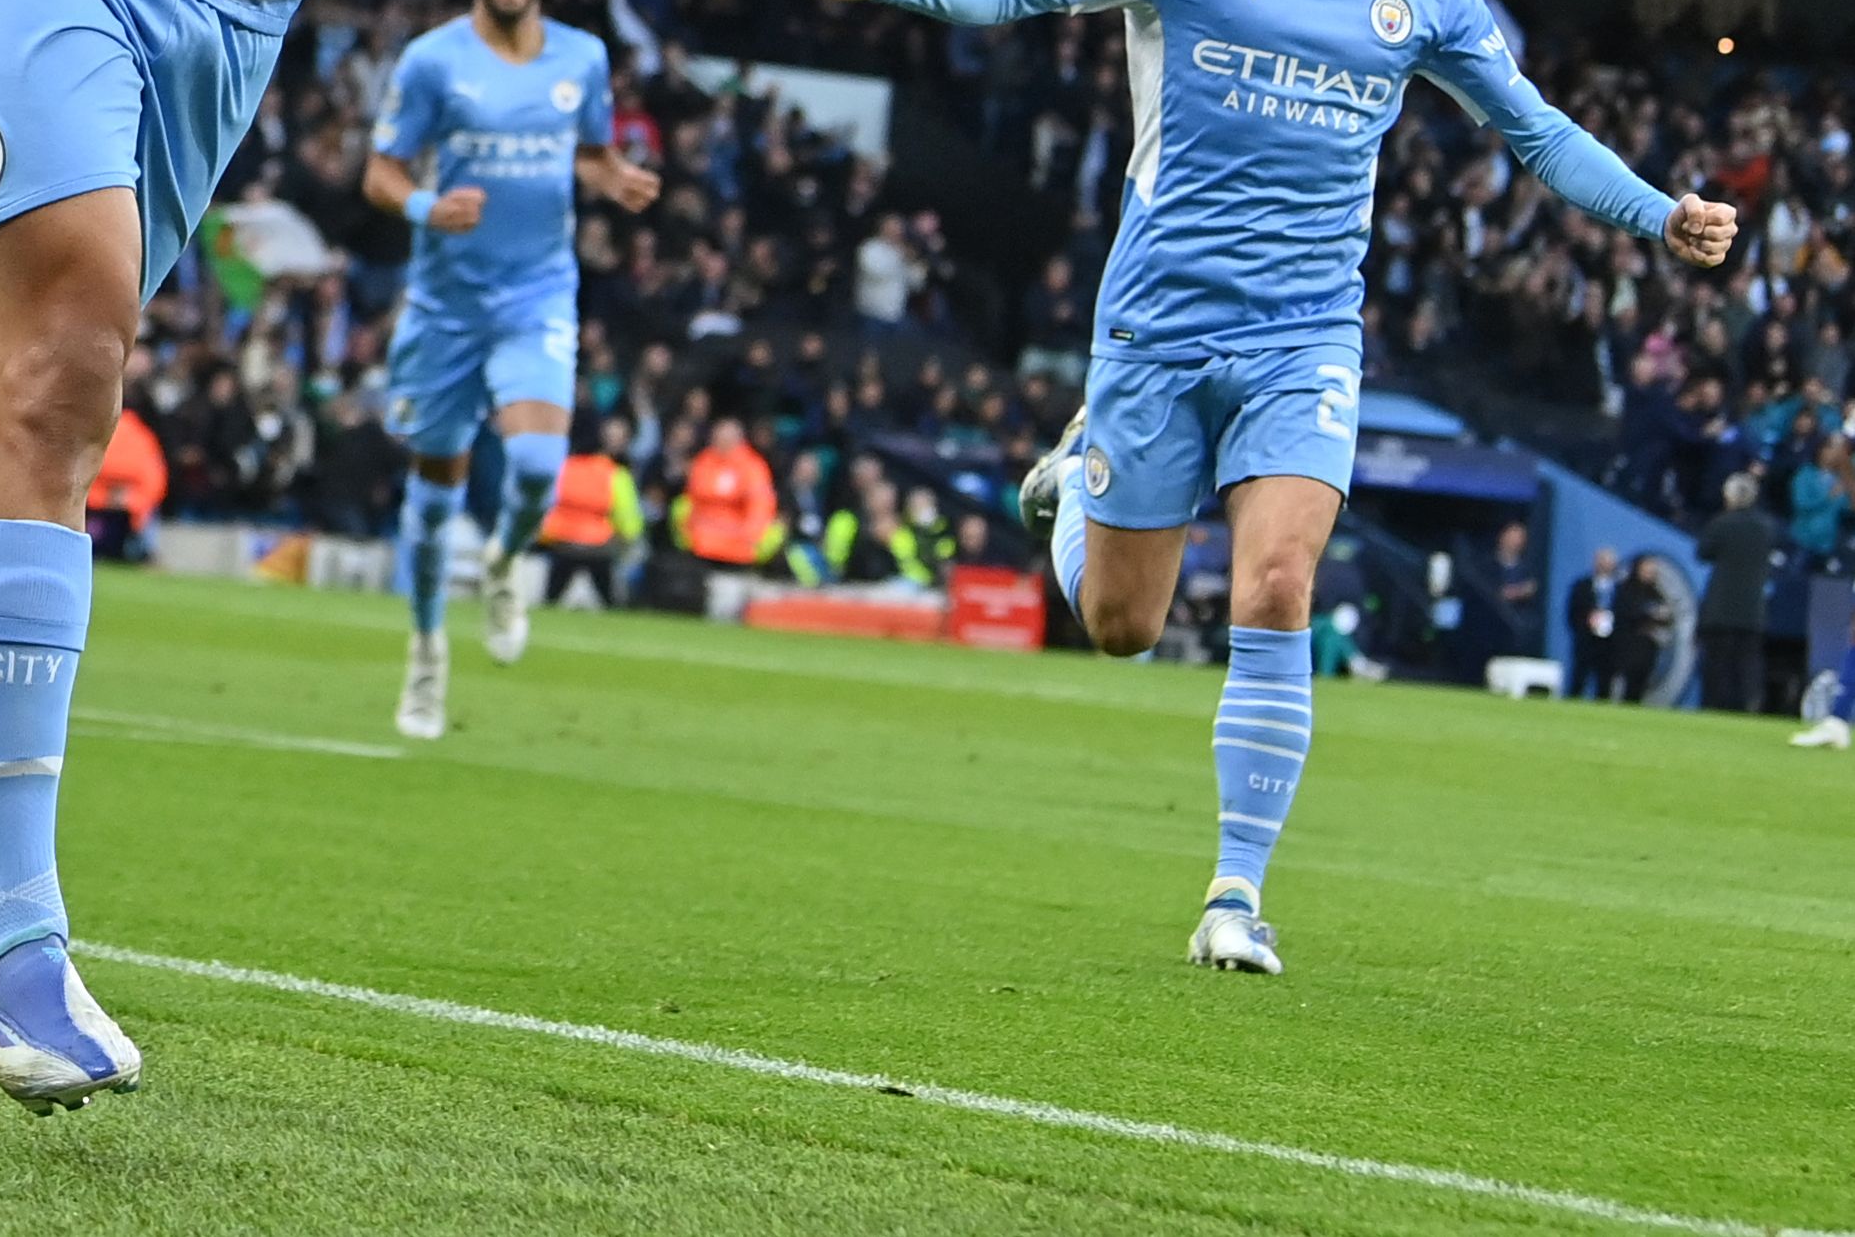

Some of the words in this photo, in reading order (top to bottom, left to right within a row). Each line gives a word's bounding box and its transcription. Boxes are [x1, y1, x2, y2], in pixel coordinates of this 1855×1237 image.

[1192, 38, 1393, 108] ETIHAD
[1222, 89, 1361, 135] AIRWAYS
[1248, 772, 1297, 795] CITY
